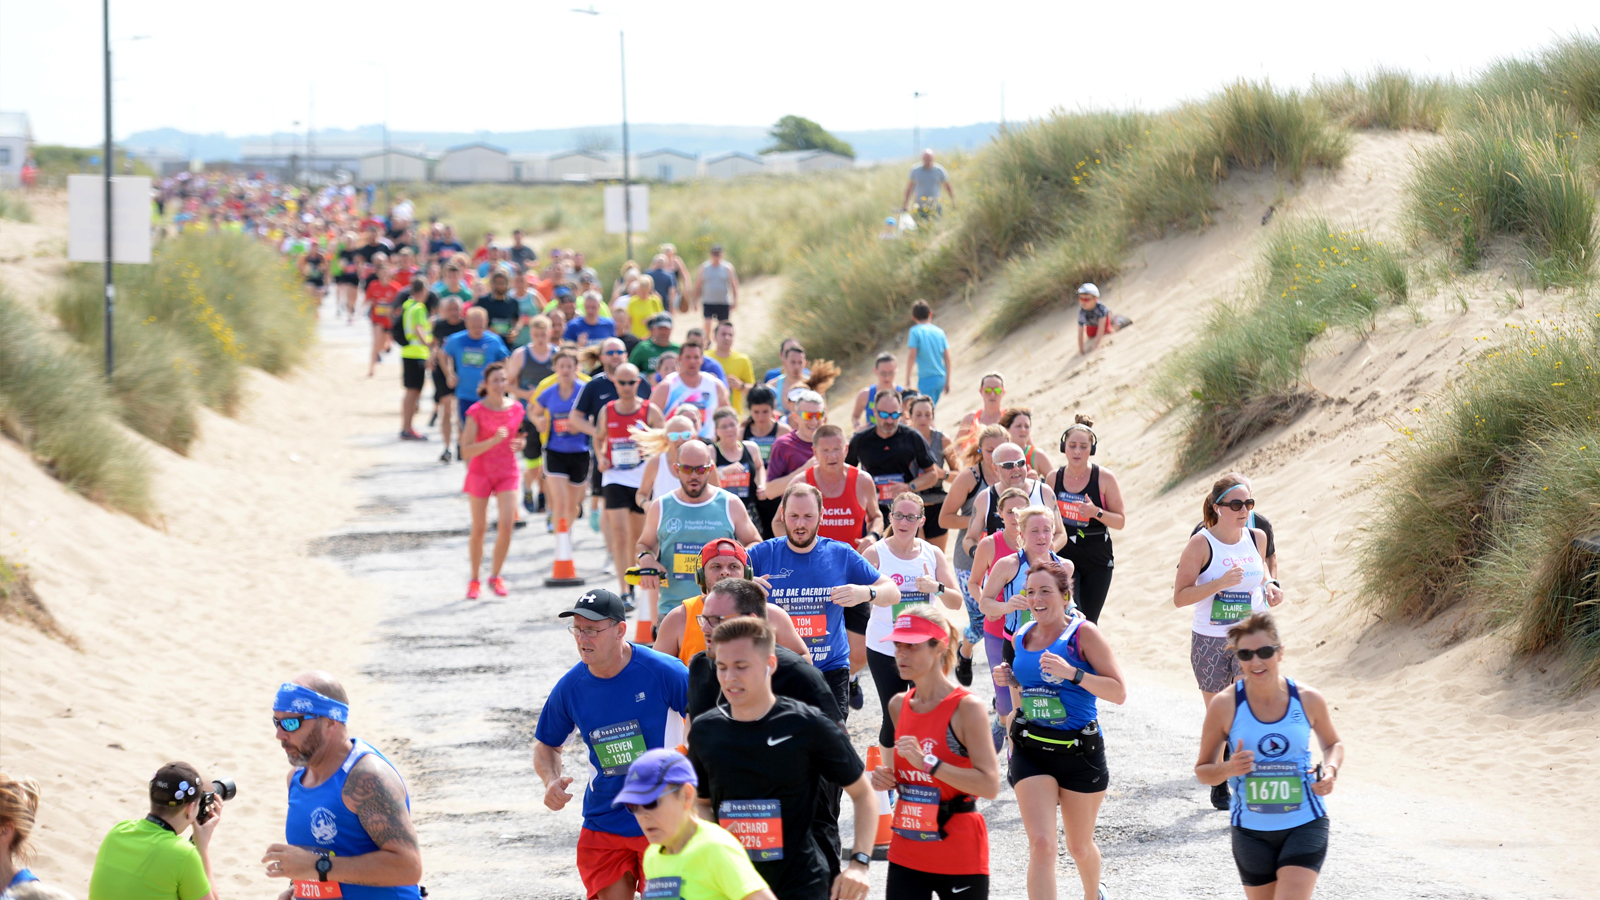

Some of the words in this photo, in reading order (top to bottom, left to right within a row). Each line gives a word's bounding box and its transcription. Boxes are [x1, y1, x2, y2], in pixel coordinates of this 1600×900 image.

[823, 507, 852, 516] ACKLA
[820, 518, 855, 526] RRIERS
[1222, 556, 1254, 567] Claire
[771, 588, 784, 597] RAS
[786, 588, 799, 597] BAE
[1222, 604, 1243, 612] CLAIRE
[796, 618, 811, 626] TOM
[1032, 699, 1048, 707] SIAN
[1032, 709, 1051, 718] 1144
[601, 723, 638, 736] healthspan
[605, 740, 634, 754] STEVEN
[612, 751, 632, 765] 1320
[1249, 781, 1290, 800] 1670
[901, 804, 923, 817] JAYNE
[901, 817, 921, 829] 2516
[739, 835, 761, 847] 2296
[301, 883, 320, 898] 2370
